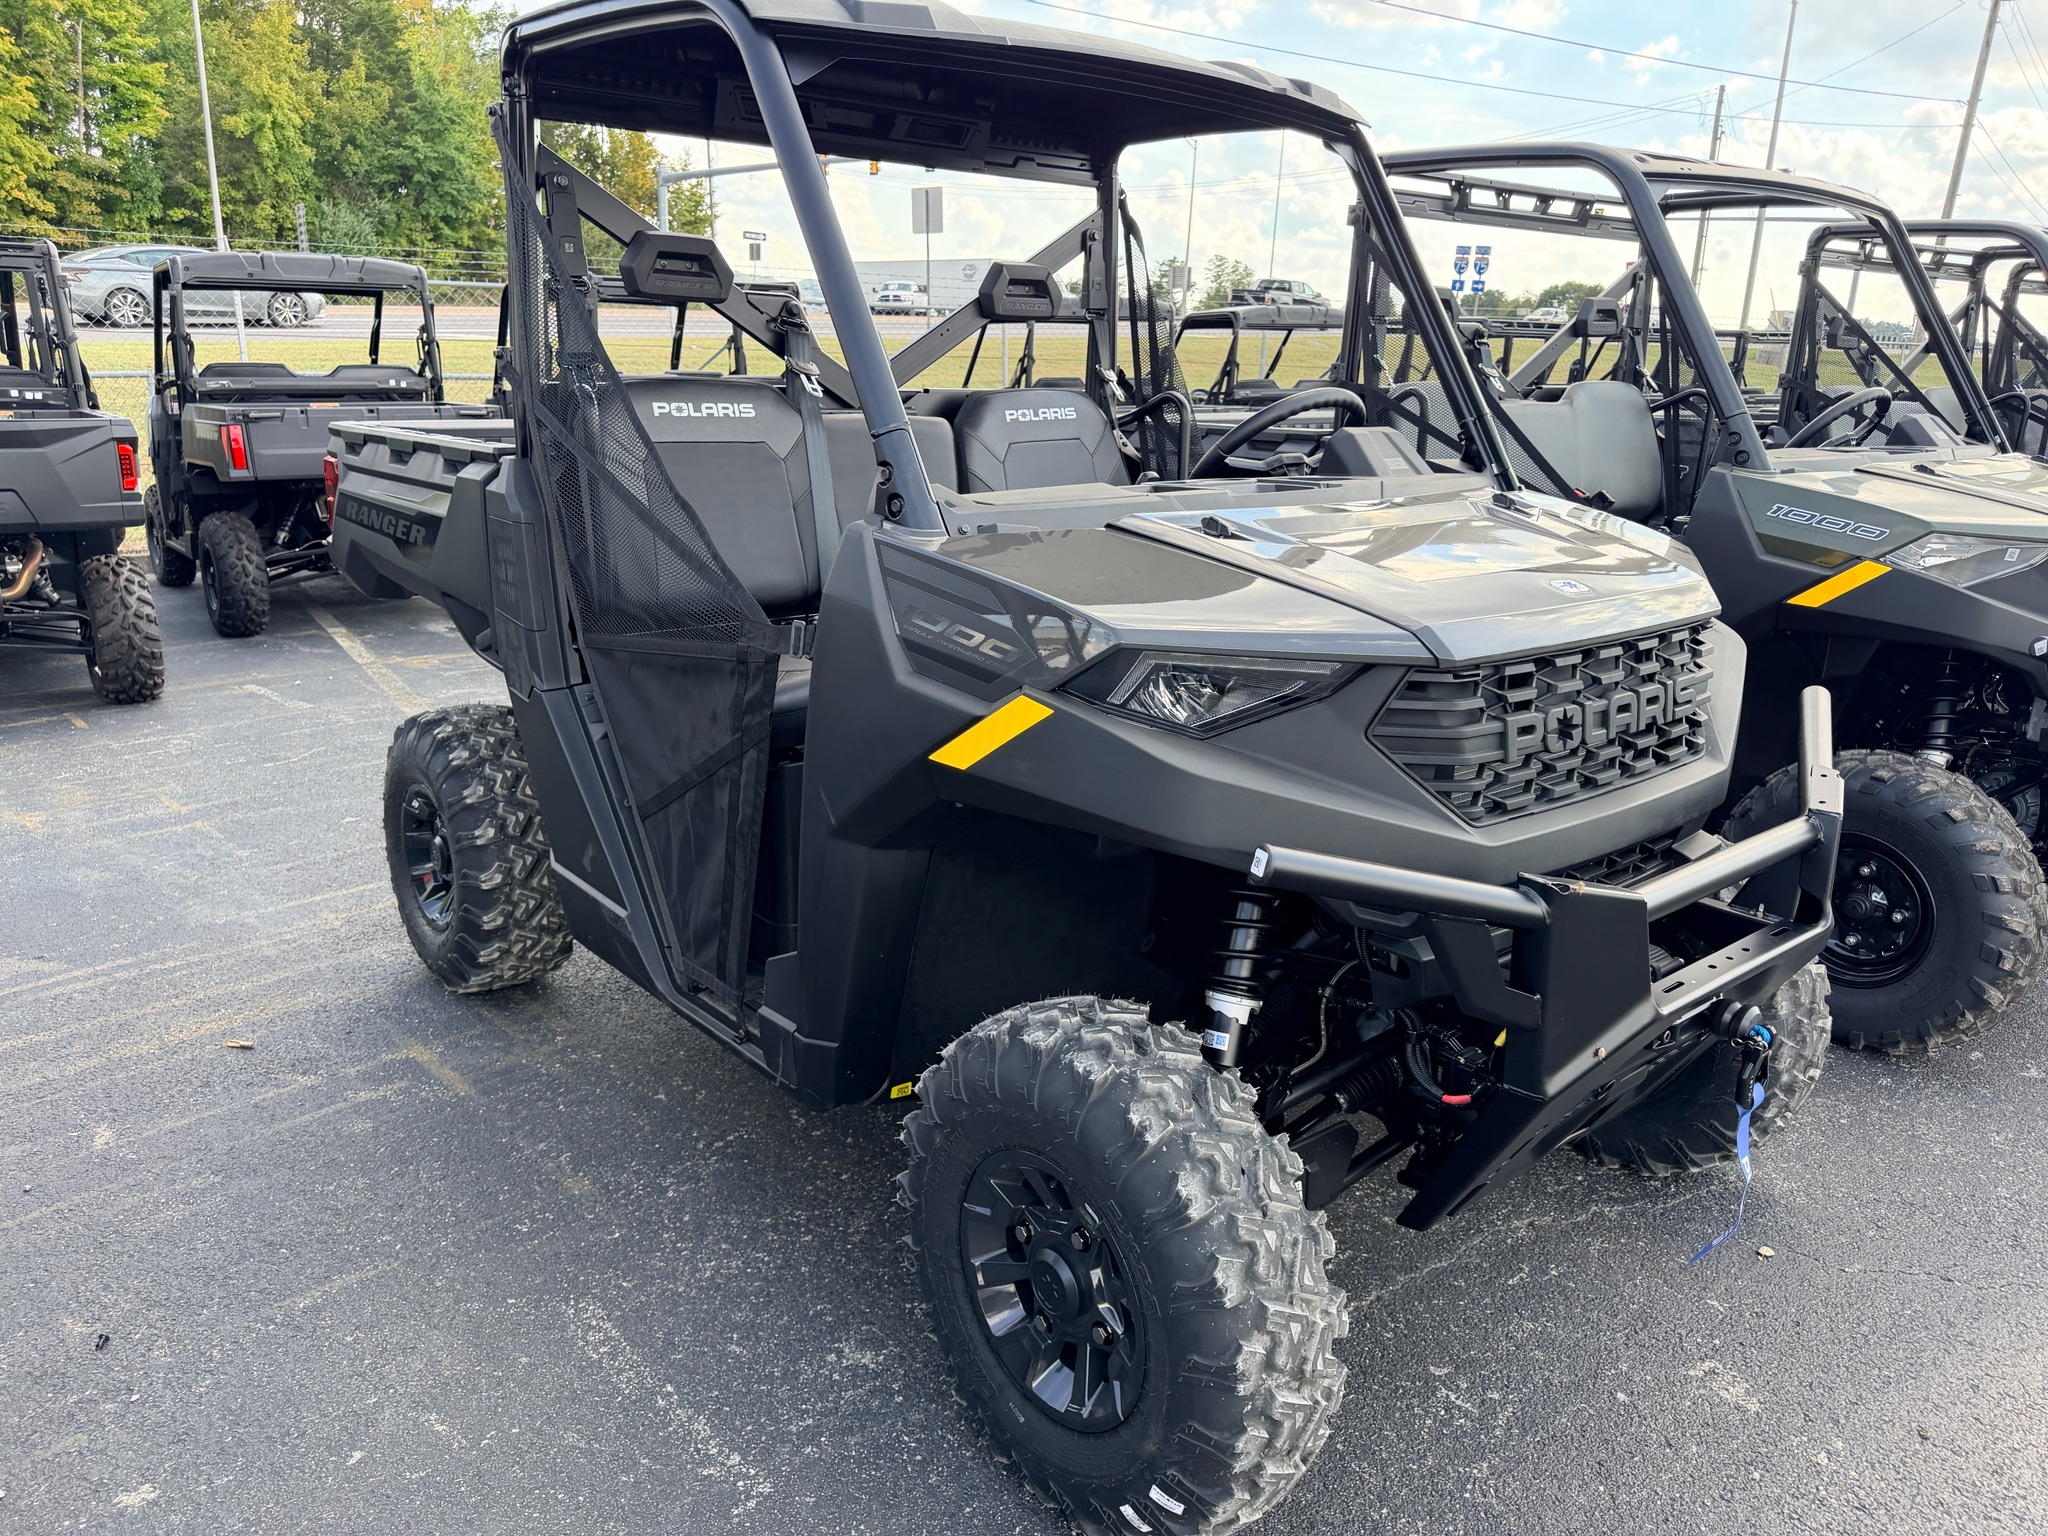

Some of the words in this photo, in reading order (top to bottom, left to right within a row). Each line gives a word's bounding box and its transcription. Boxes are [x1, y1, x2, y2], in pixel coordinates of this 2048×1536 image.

[1456, 261, 1467, 273] 75
[1475, 261, 1487, 273] 75
[655, 279, 715, 290] RANGER
[1007, 302, 1048, 310] RANGER
[652, 402, 756, 417] POLARIS
[1004, 407, 1077, 422] POLARIS
[346, 500, 426, 546] RANGER
[1767, 503, 1890, 541] 1000
[903, 624, 934, 640] SINGLE
[936, 638, 986, 662] OVERHEAD
[1501, 670, 1698, 764] POLARIS
